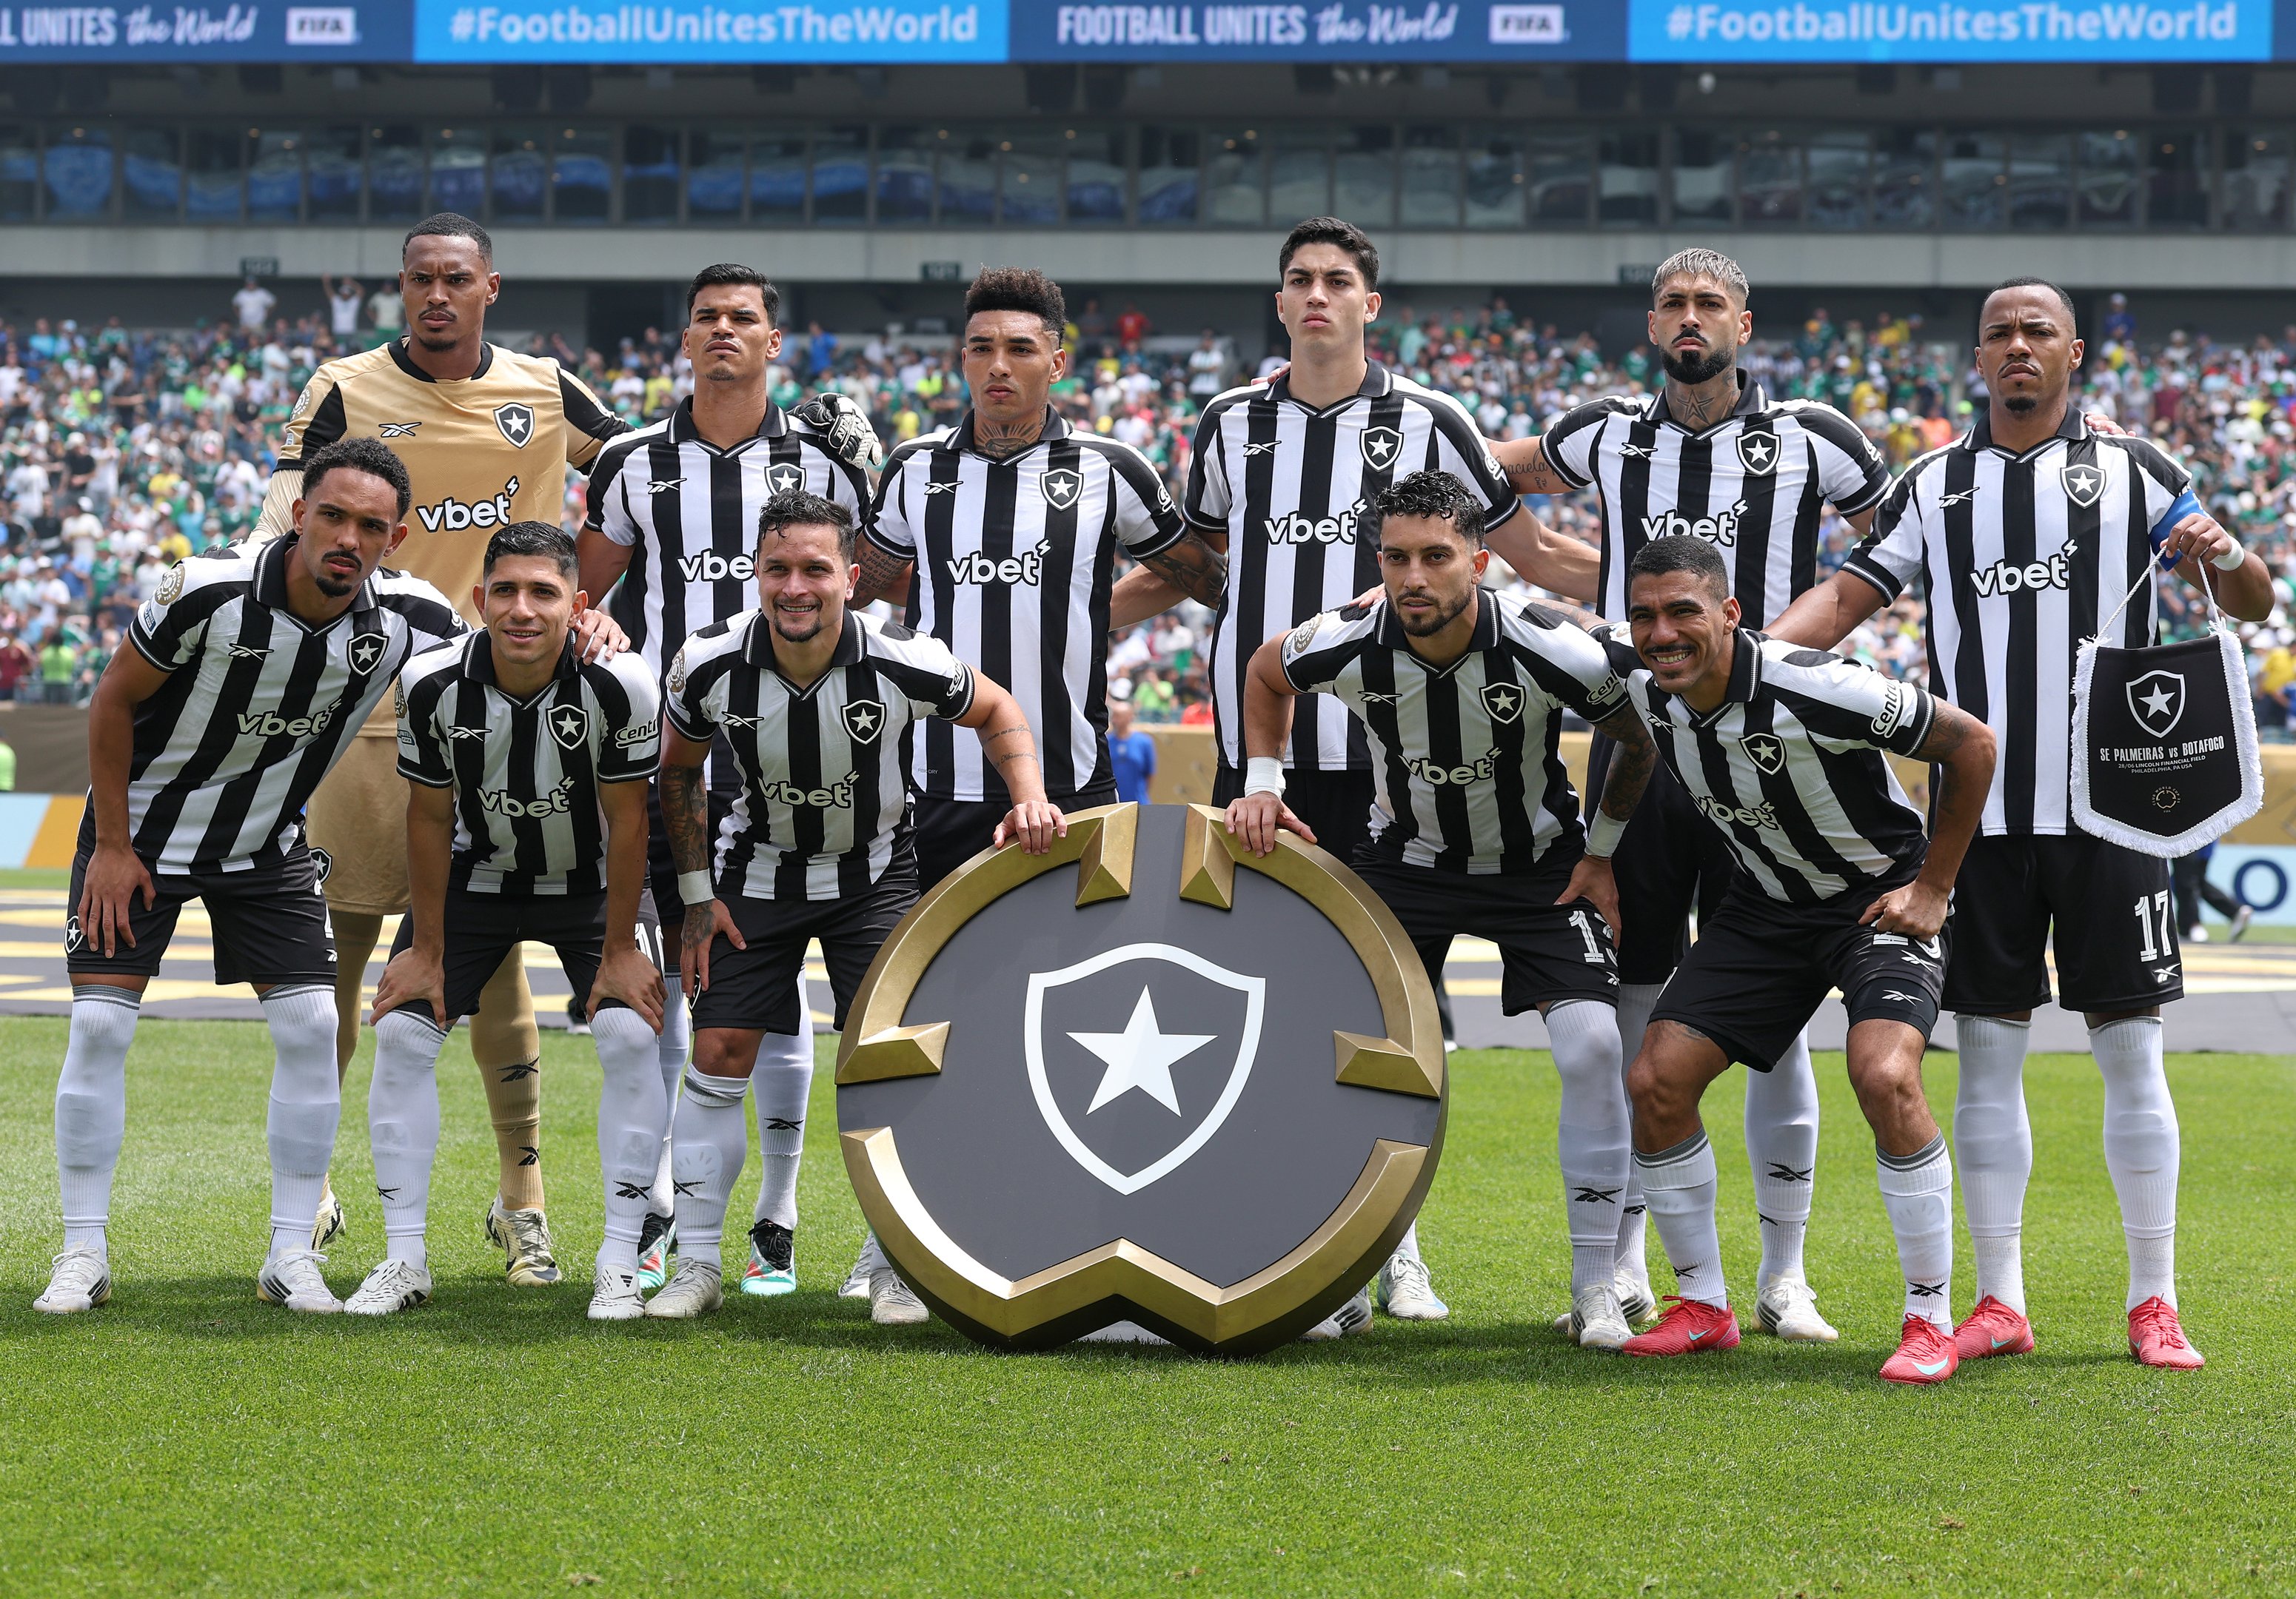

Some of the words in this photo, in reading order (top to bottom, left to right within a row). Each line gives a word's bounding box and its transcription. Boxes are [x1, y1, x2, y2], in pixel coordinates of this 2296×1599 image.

[22, 7, 116, 46] UNITES
[122, 5, 173, 46] the
[173, 3, 258, 45] World
[296, 16, 344, 34] FIFA
[449, 4, 978, 43] #FootballUnitesTheWorld
[1057, 5, 1200, 44] FOOTBALL
[1204, 4, 1307, 44] UNITES
[1315, 4, 1365, 44] the
[1368, 2, 1459, 43] World
[1500, 15, 1552, 34] FIFA
[1666, 1, 2237, 41] #FootballUnitesTheWorld
[415, 492, 511, 532] vbet
[1264, 511, 1356, 546] vbet
[677, 549, 756, 583] vbe
[946, 550, 1038, 586] vbet
[1969, 554, 2067, 596] vbet
[237, 711, 326, 737] vbet
[2100, 748, 2110, 762] SE
[2114, 746, 2165, 762] PALMEIRAS
[2181, 735, 2225, 757] BOTAFOGO
[2161, 758, 2190, 767] FINANCIAL
[2131, 765, 2173, 774] PHILADELPHIA,
[476, 788, 567, 817] vbet
[757, 782, 851, 807] vbet
[2134, 889, 2172, 962] 17
